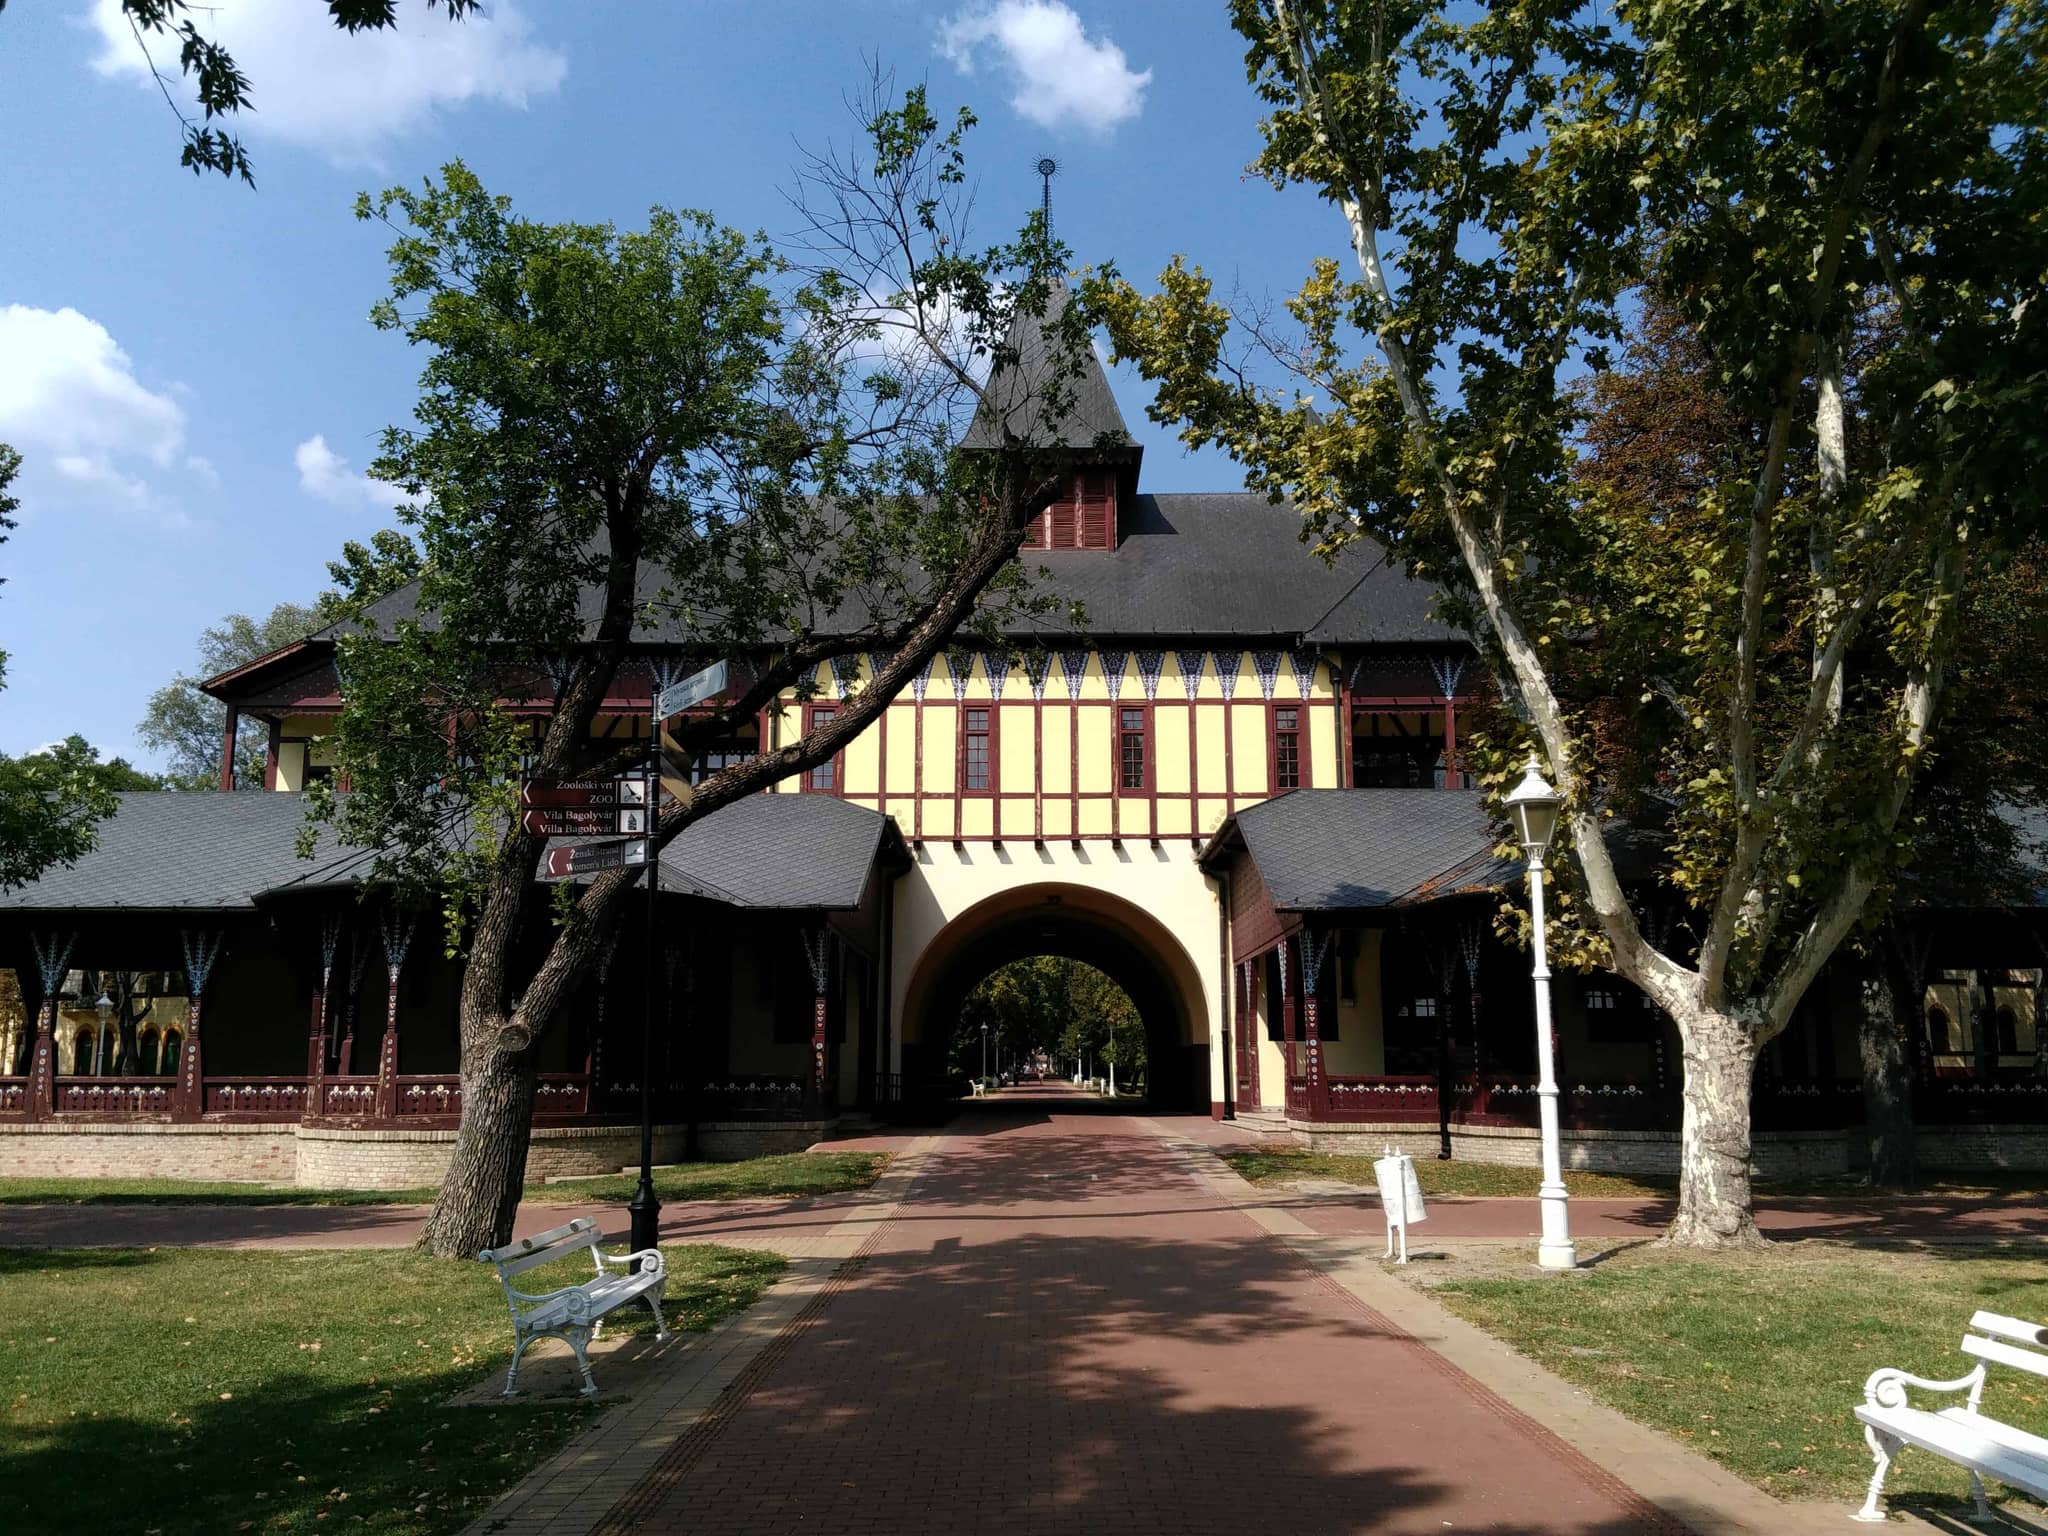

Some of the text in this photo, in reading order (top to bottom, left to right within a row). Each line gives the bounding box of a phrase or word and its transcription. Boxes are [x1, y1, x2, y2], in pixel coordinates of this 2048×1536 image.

[556, 780, 613, 790] Zoološki vrt
[589, 794, 614, 804] ZOO
[543, 810, 563, 820] Vila
[539, 824, 563, 834] Villa
[601, 857, 619, 868] Lido
